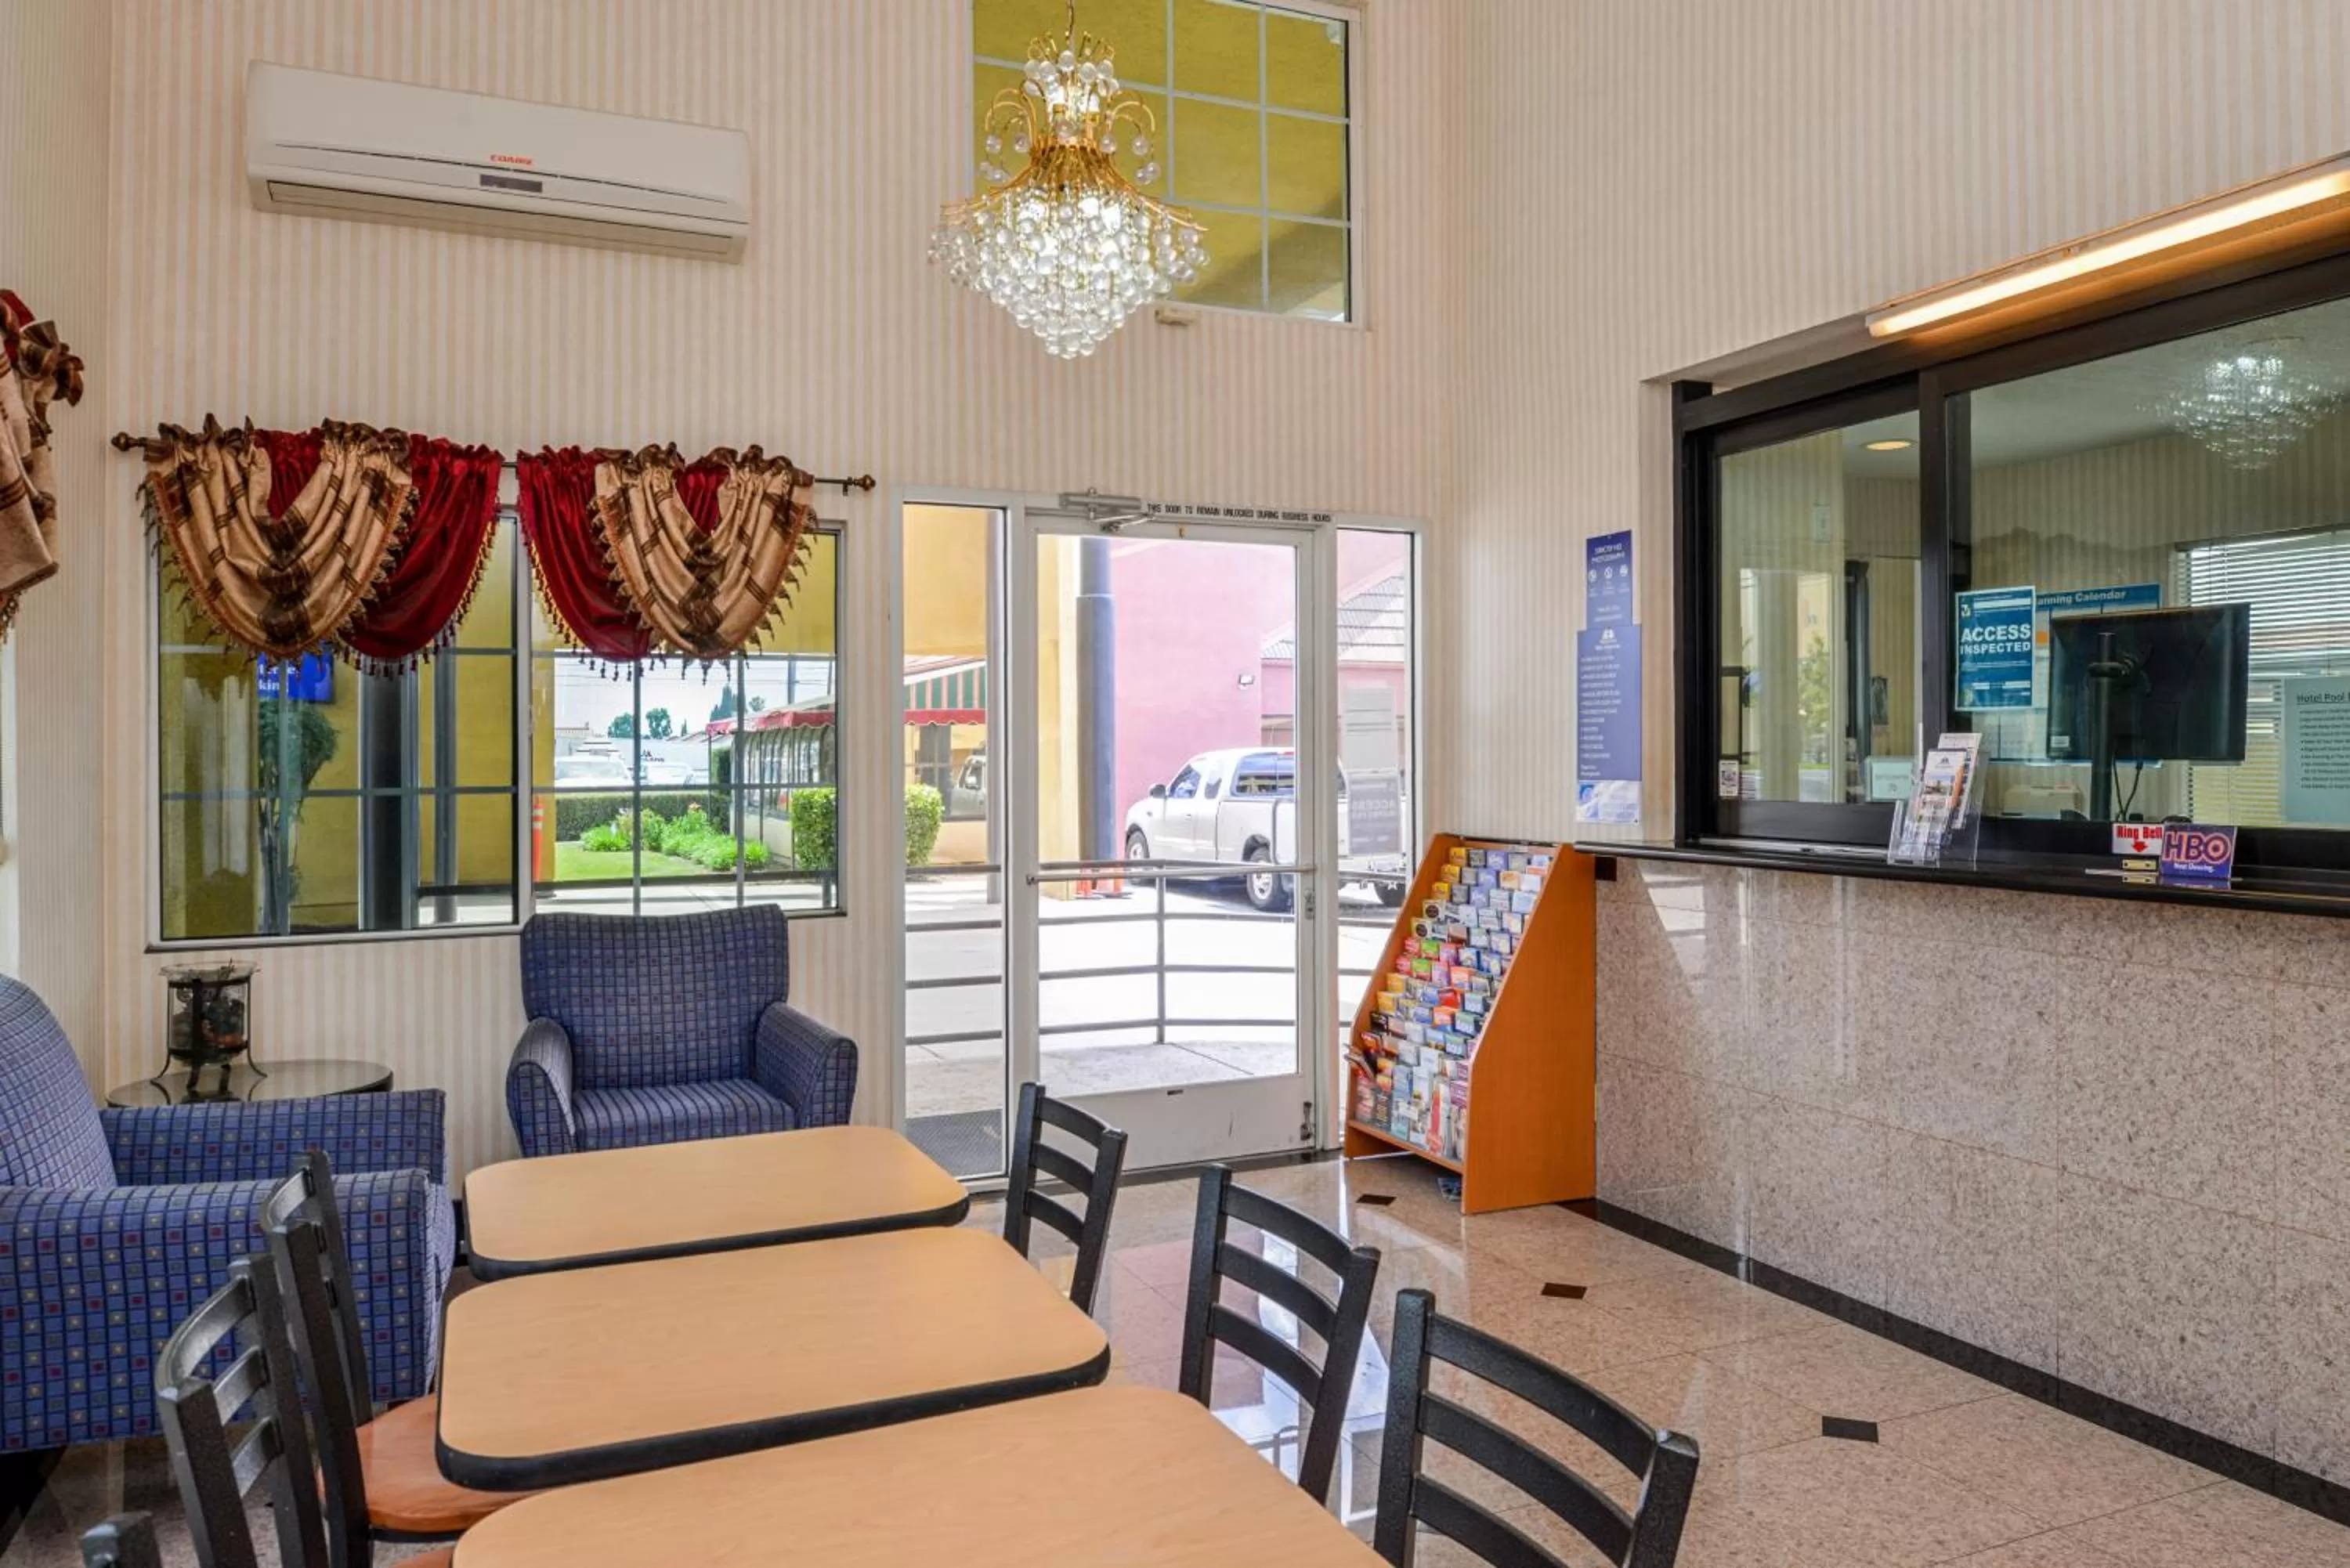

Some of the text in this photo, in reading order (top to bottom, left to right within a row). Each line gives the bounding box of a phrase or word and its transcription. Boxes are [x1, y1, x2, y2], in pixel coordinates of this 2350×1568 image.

[2037, 589, 2127, 605] anning Calendar
[1961, 623, 2031, 643] ACCESS
[1960, 641, 2031, 655] INSPECTED
[2297, 692, 2345, 703] Hotel Pool
[2117, 826, 2163, 839] Ring Bell
[2162, 832, 2232, 864] HBO
